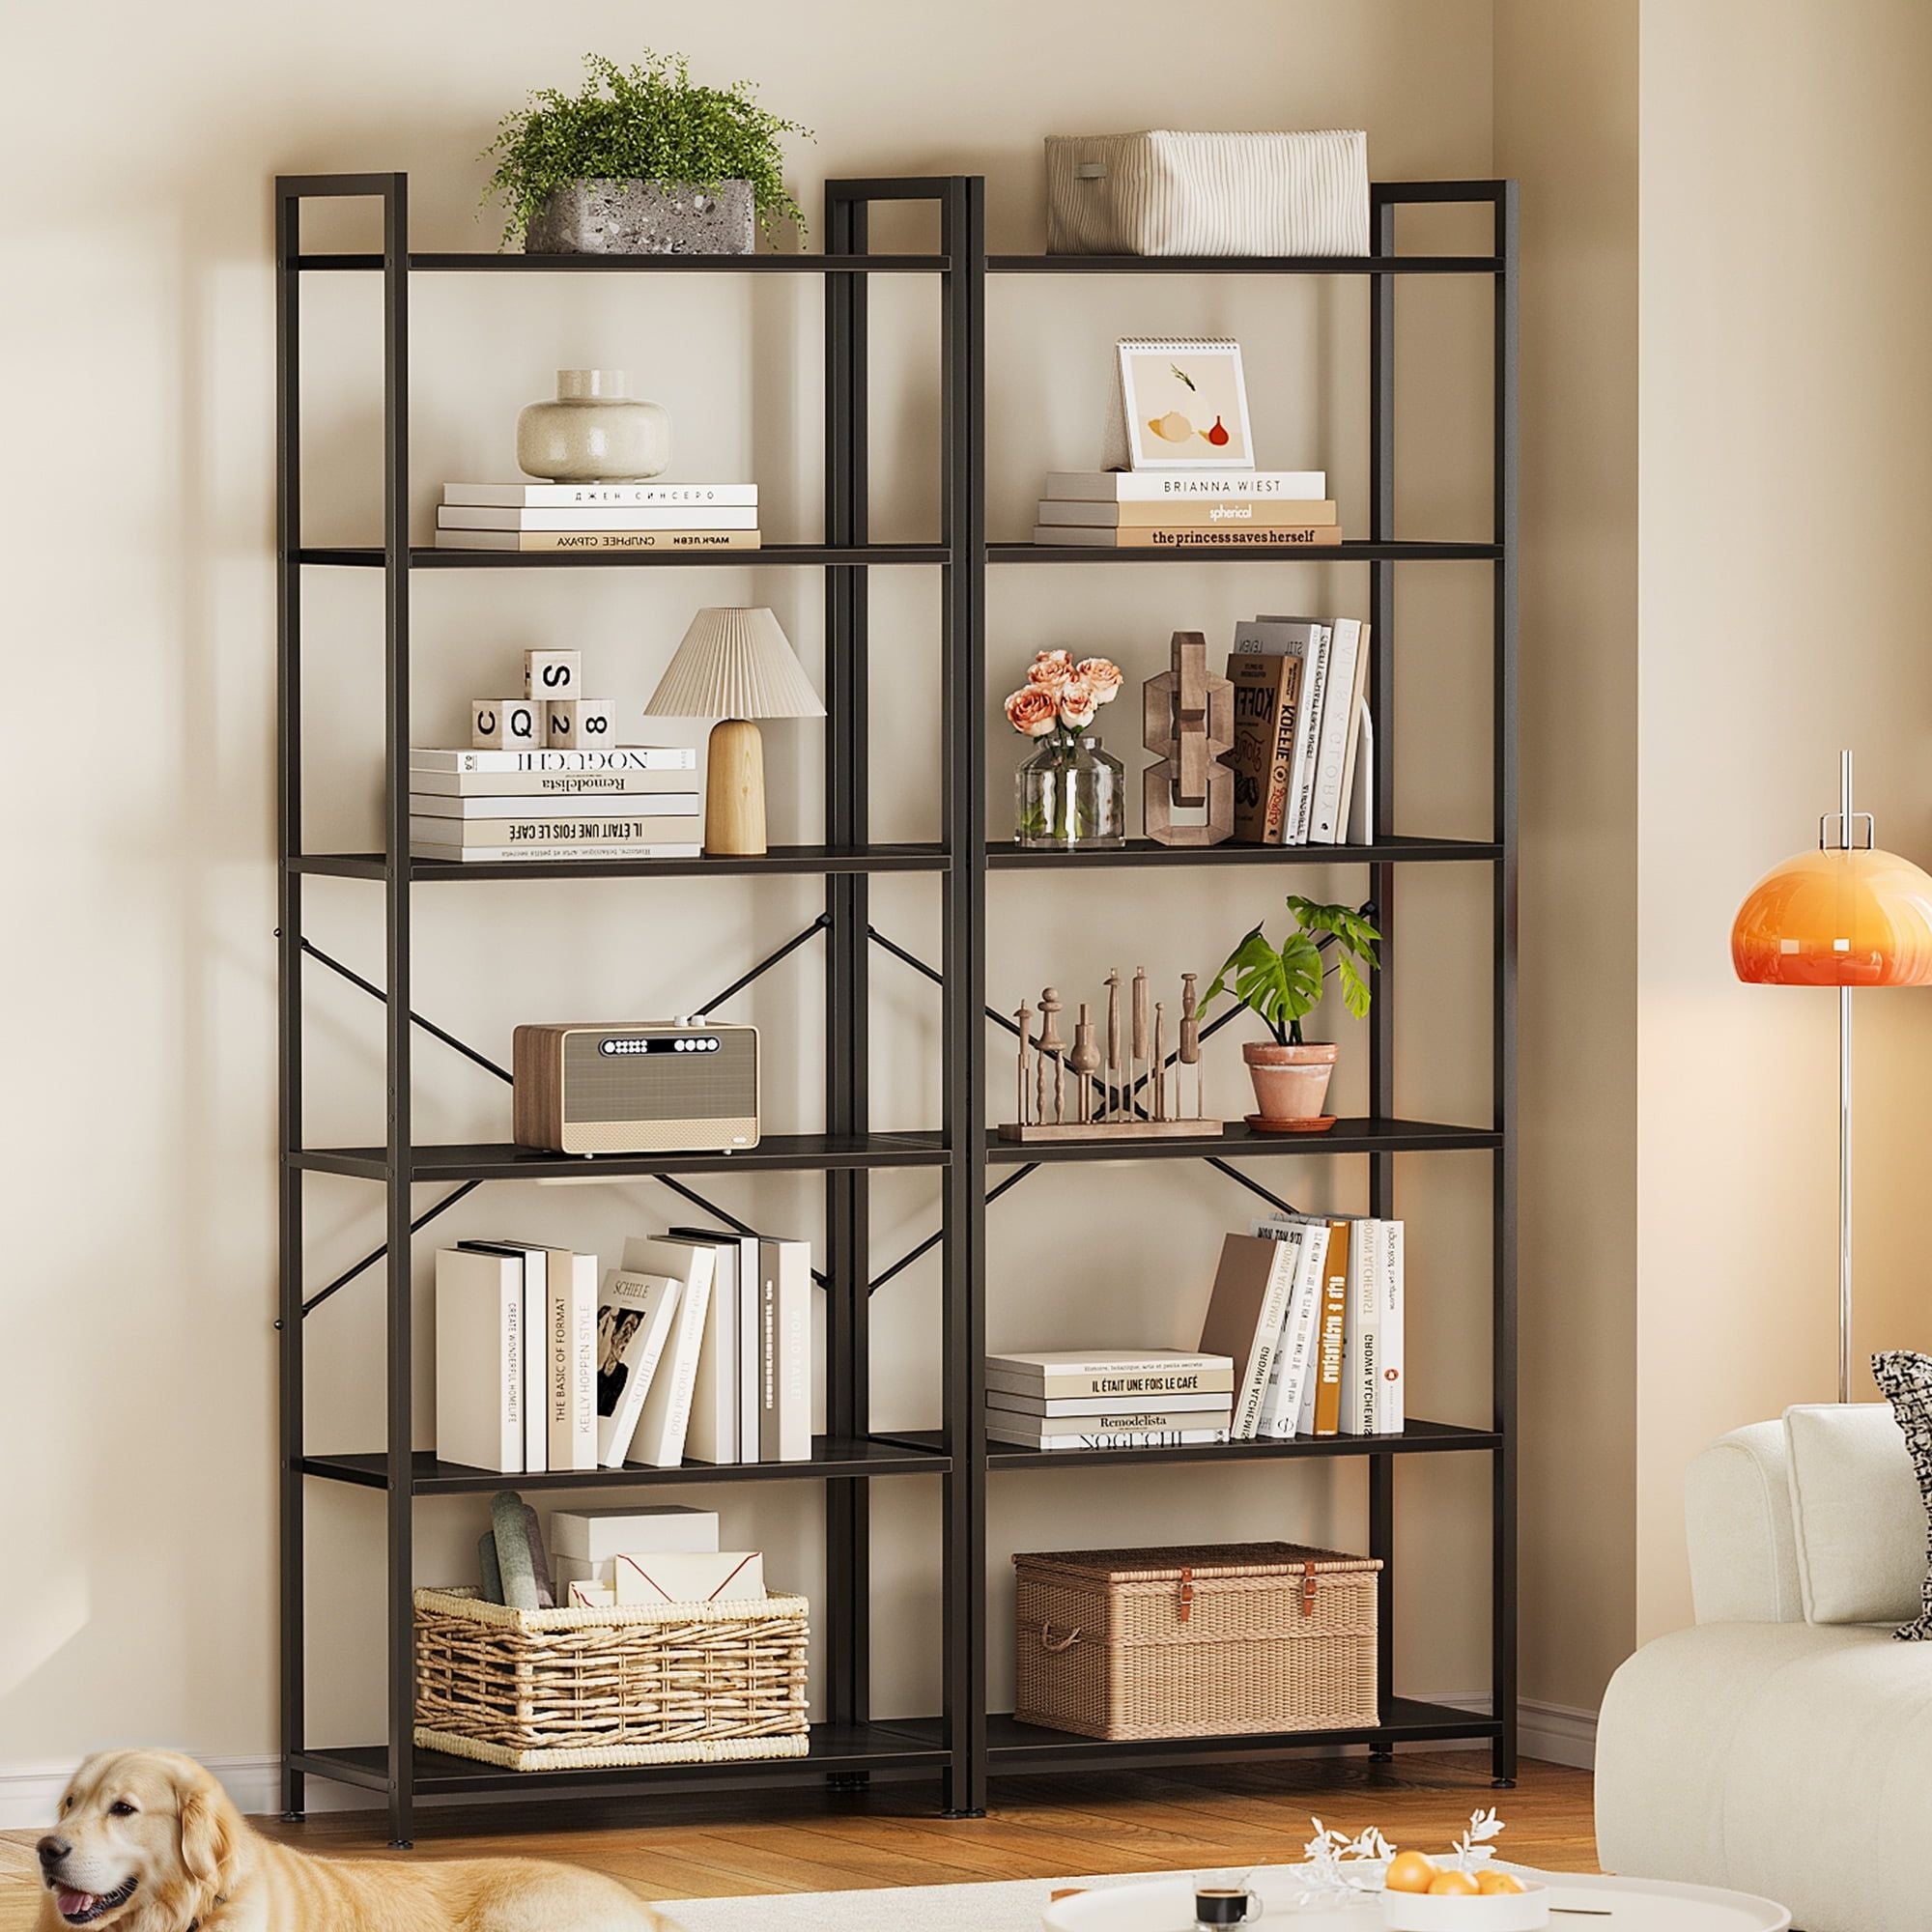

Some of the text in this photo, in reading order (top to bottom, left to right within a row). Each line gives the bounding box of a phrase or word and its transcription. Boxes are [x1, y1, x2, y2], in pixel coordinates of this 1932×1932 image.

[575, 491, 714, 500] ДЖЕН СИНСЕРО
[1164, 480, 1281, 493] BRIANNA WIEST
[1209, 503, 1253, 522] spherical
[543, 665, 571, 688] S
[477, 710, 496, 735] C
[511, 709, 532, 738] Q
[553, 715, 570, 734] 2
[585, 716, 608, 734] 8
[518, 751, 648, 771] NOGUCHI
[541, 778, 625, 792] Remodelista
[509, 822, 642, 842] IL ÉTAIT UNE FOIS LE CAFÉ
[612, 1280, 650, 1299] SCHIELE
[507, 1302, 516, 1422] CREATE WONDERFUL HOMELIFE
[554, 1297, 565, 1421] THE BASIC OF FORMAT
[580, 1304, 589, 1433] KELLY HOPPEN STYLE
[1092, 1374, 1198, 1393] IL ÉTAIT UNE FOIS LE CAFÉ
[1100, 1414, 1167, 1428] Remodelista
